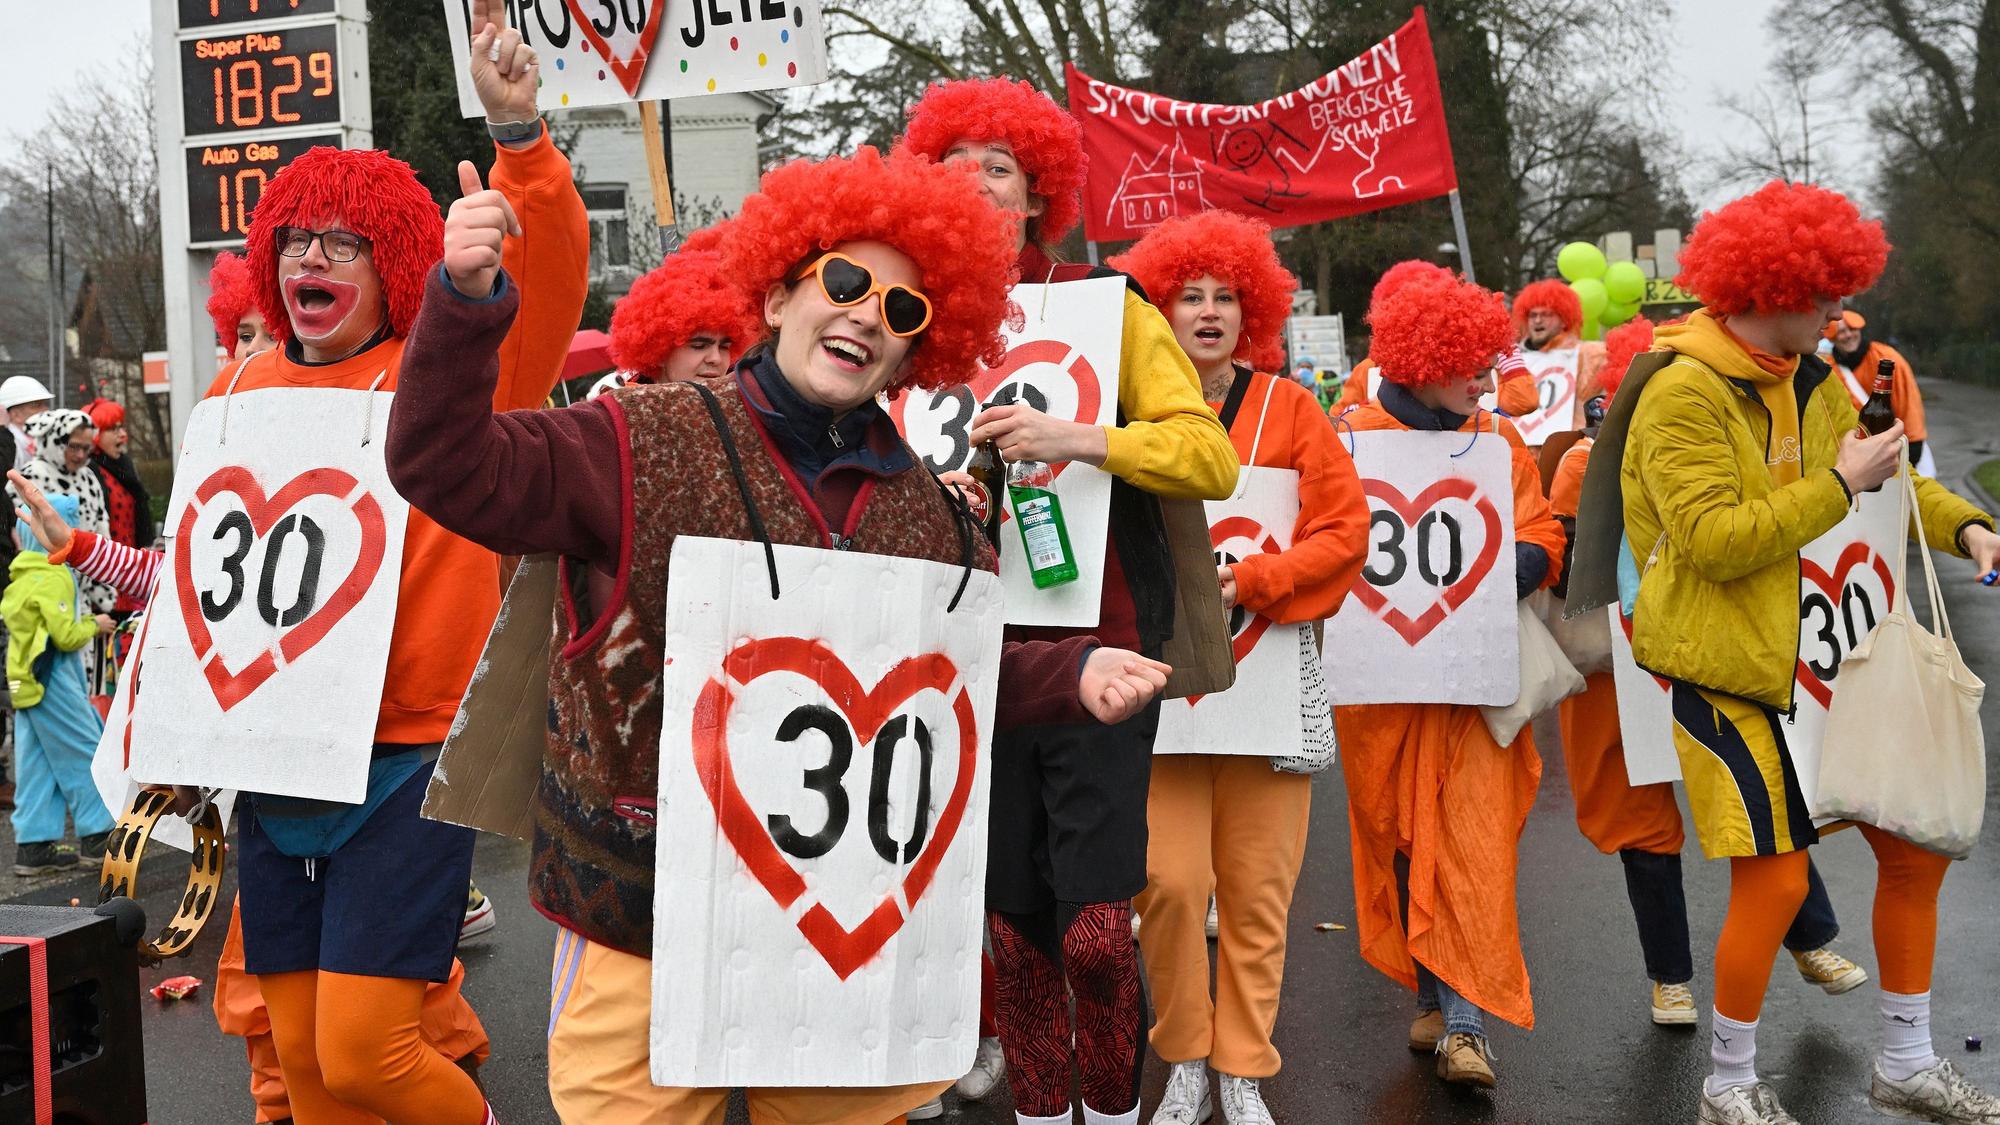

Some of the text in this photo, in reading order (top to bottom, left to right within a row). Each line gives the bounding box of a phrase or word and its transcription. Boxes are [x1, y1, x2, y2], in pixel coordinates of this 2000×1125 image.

[196, 34, 281, 59] Super Plus
[1308, 75, 1411, 130] BERGISCHE
[1331, 99, 1417, 151] SCHWEIZ
[202, 143, 279, 166] Auto Gas
[201, 510, 326, 627] 30
[1361, 509, 1462, 587] 30
[768, 704, 932, 865] 30
